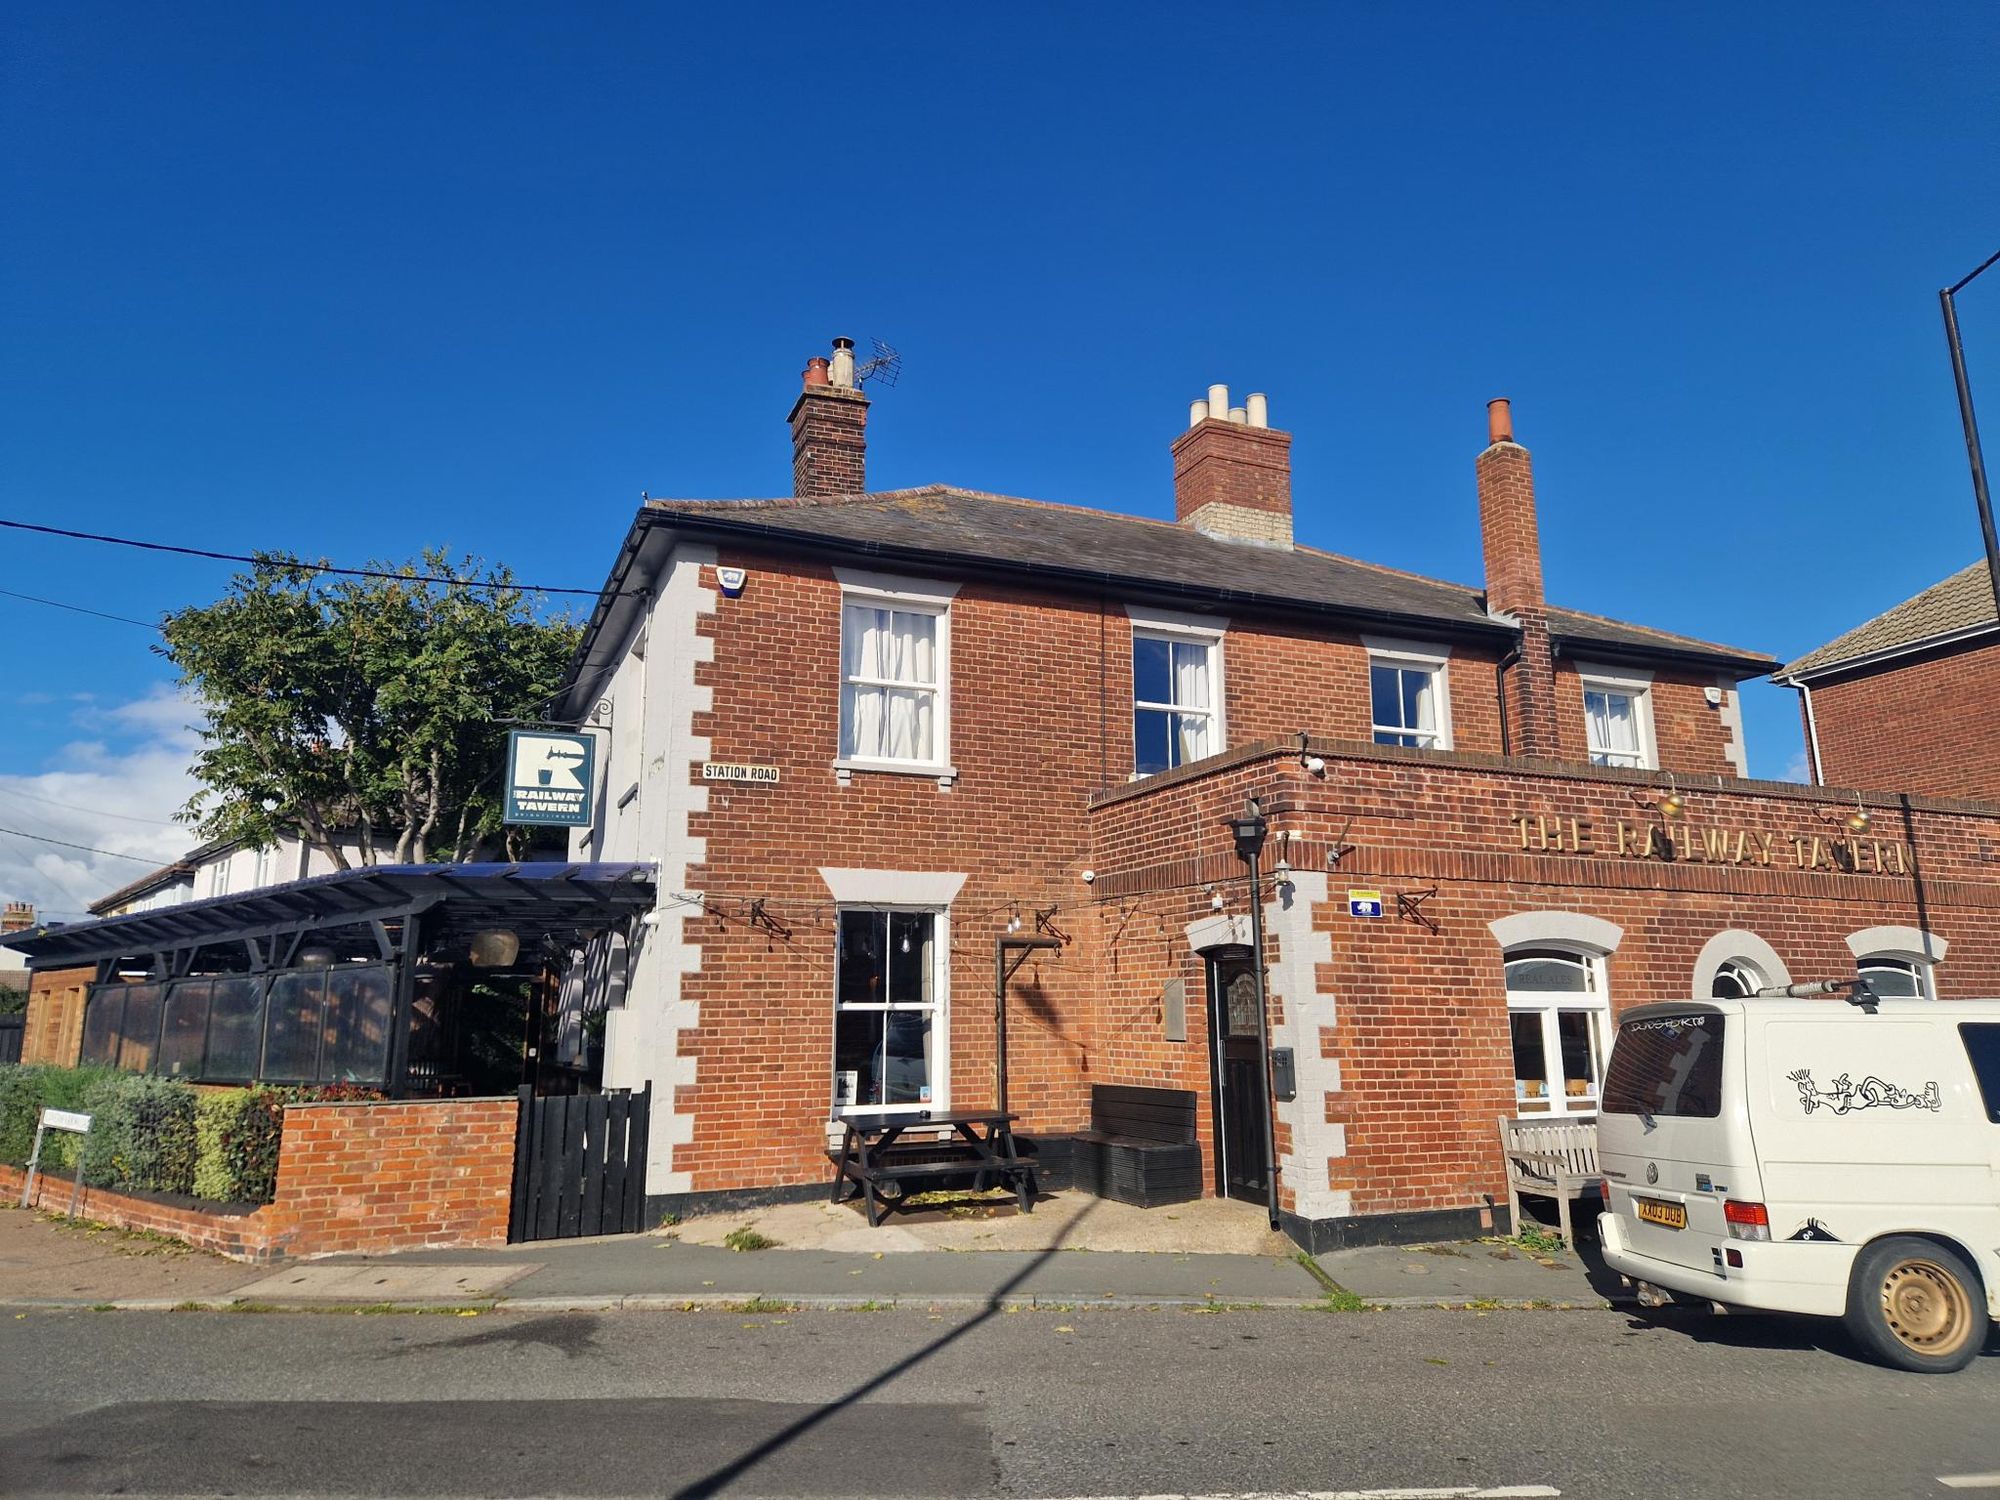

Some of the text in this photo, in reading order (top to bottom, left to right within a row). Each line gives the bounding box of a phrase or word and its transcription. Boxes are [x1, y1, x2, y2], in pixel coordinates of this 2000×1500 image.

[705, 765, 777, 781] STATION ROAD
[516, 790, 585, 802] RAILWAY
[517, 801, 580, 813] TAVERN
[1510, 813, 1918, 876] THE RAILWAY TAVERN
[1518, 974, 1546, 985] REAL
[1664, 1205, 1682, 1224] DUB
